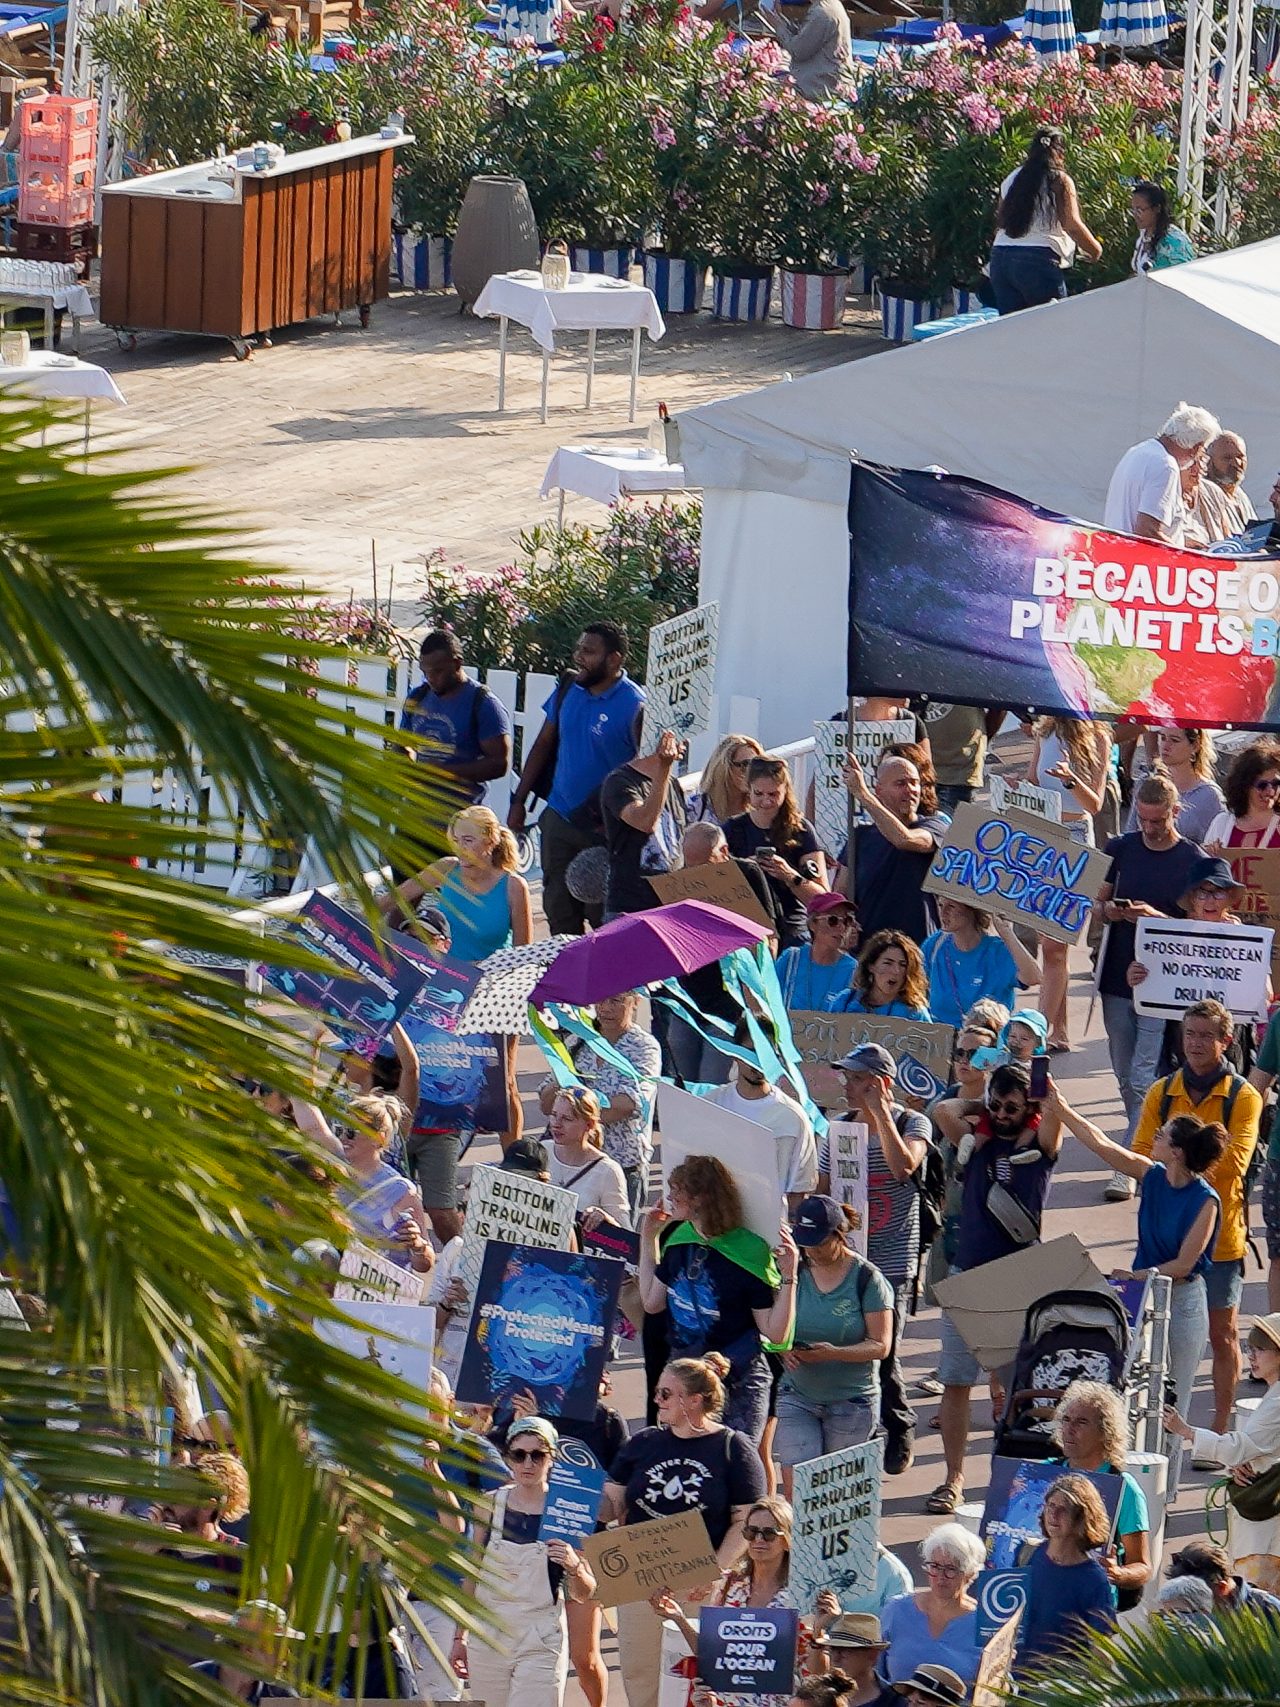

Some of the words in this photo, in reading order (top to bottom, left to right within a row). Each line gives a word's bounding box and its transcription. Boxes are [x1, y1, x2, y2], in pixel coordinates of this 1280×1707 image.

[1032, 557, 1241, 610] BECAUSE
[663, 618, 705, 647] BOTTOM
[1010, 600, 1192, 651] PLANET
[1195, 612, 1245, 656] IS
[667, 654, 709, 681] KILLING
[668, 679, 691, 706] US
[1003, 789, 1046, 814] BOTTOM
[975, 819, 1090, 889] OCEAN
[931, 845, 1004, 895] SANS
[1143, 941, 1263, 964] #FOSSILFREEOCEAN
[1162, 962, 1179, 976] NO
[1181, 963, 1243, 982] OFFSHORE
[1174, 987, 1226, 1006] DRILLING
[416, 1042, 498, 1058] ectedMeans
[491, 1181, 555, 1214] BOTTOM
[475, 1220, 491, 1238] IS
[479, 1199, 561, 1237] TRAWLING
[479, 1302, 605, 1337] #ProtectedMeans
[504, 1321, 575, 1347] Protected
[810, 1457, 866, 1489] BOTTOM
[802, 1479, 874, 1515] TRAWLING
[800, 1519, 815, 1537] IS
[819, 1500, 872, 1532] KILLING
[821, 1529, 850, 1561] US
[722, 1625, 773, 1637] DROITS
[725, 1642, 767, 1656] POUR
[714, 1656, 777, 1672] L'OCÉAN
